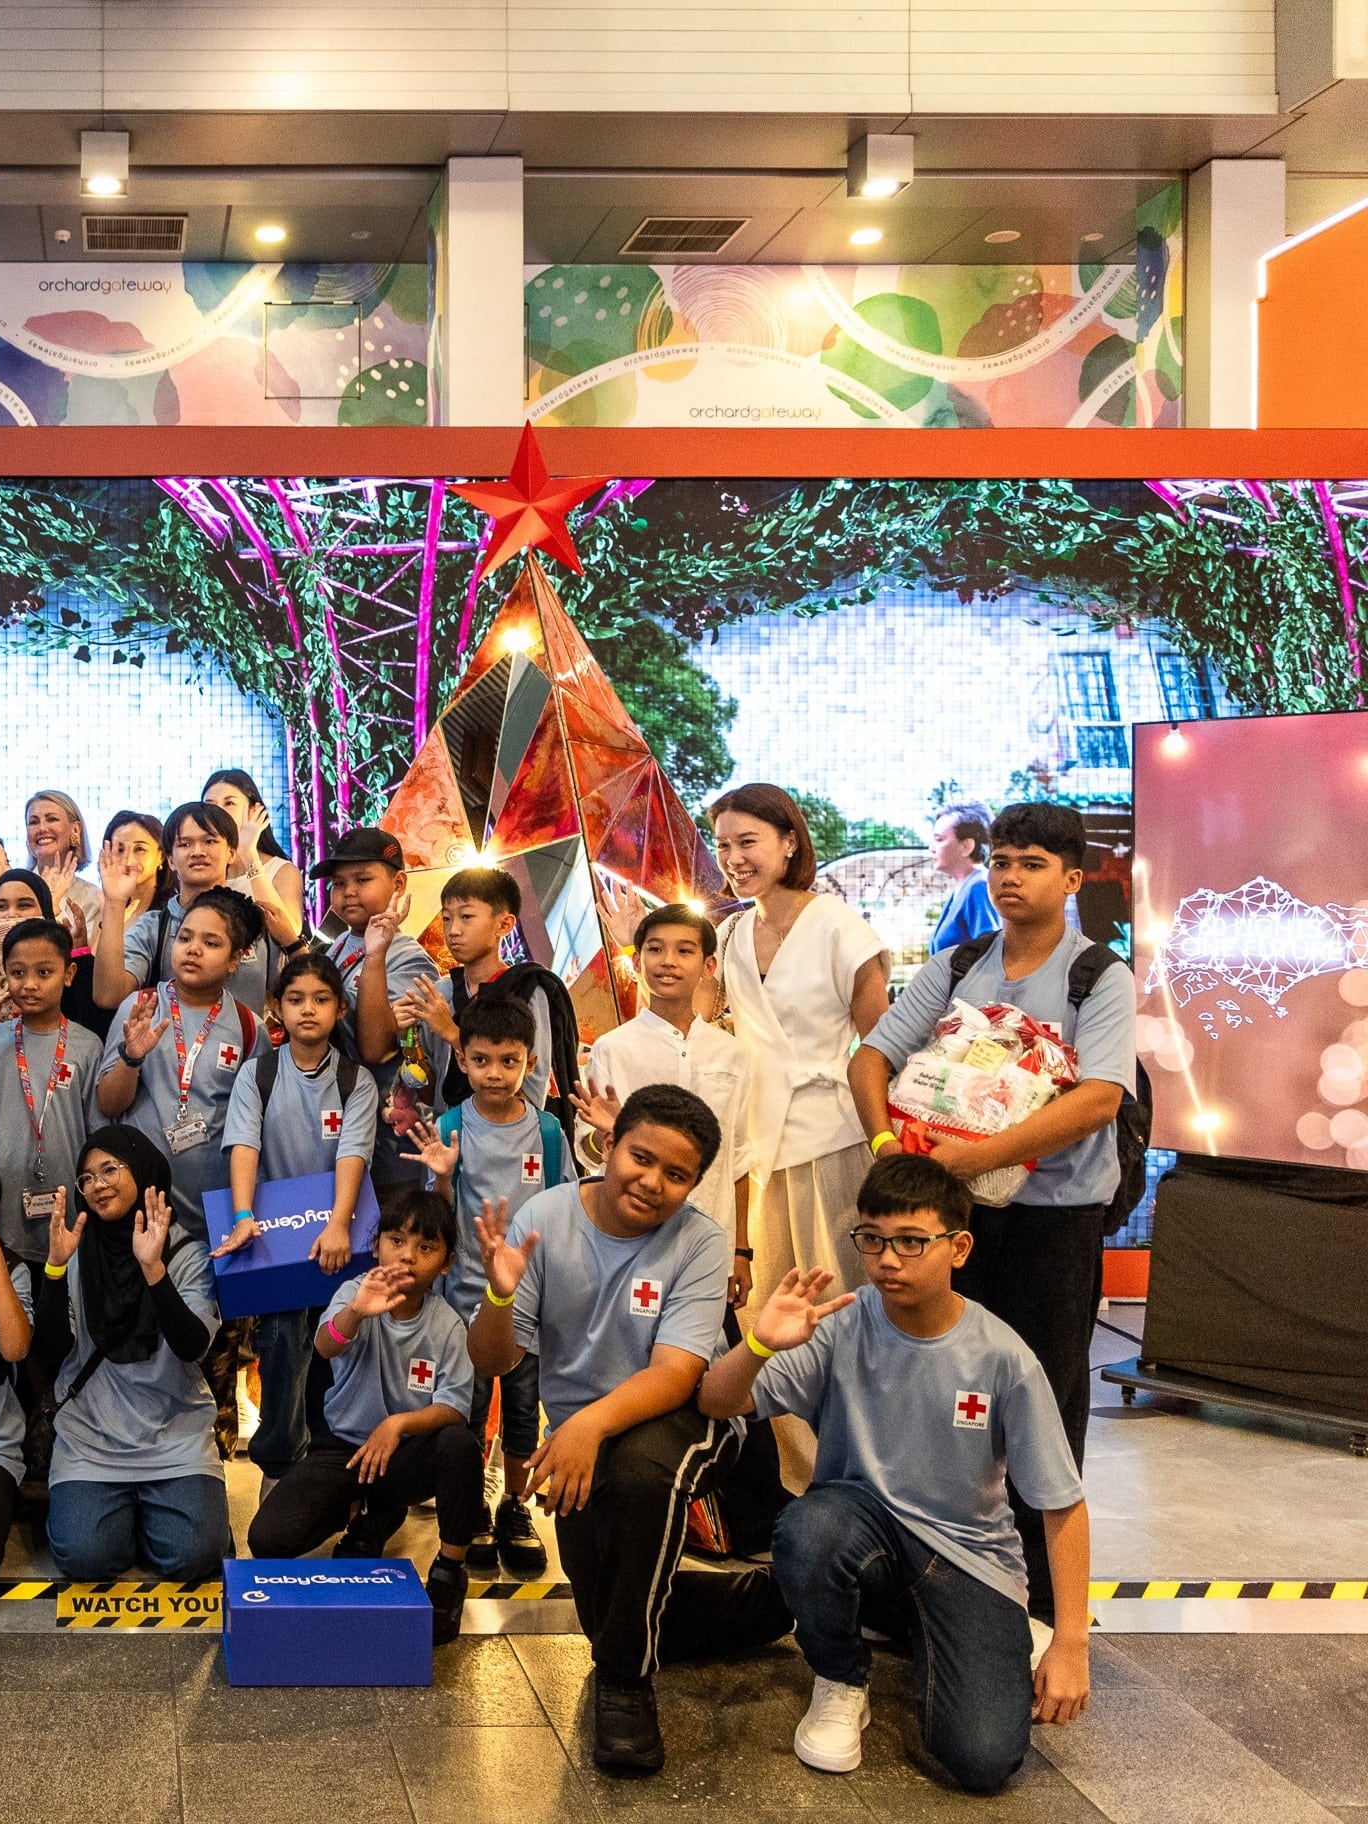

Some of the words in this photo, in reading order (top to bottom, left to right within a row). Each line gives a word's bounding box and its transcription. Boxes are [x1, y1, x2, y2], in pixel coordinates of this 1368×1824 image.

[38, 278, 172, 296] orchardgateway
[26, 339, 98, 367] orchardgateway
[531, 373, 599, 418] orchardgateway
[623, 346, 700, 367] orchardgateway
[689, 405, 822, 422] orchardgateway
[956, 1420, 985, 1428] SINGAPORE
[253, 1574, 394, 1586] babyCentral
[71, 1597, 160, 1613] WATCH
[168, 1597, 223, 1613] YOU
